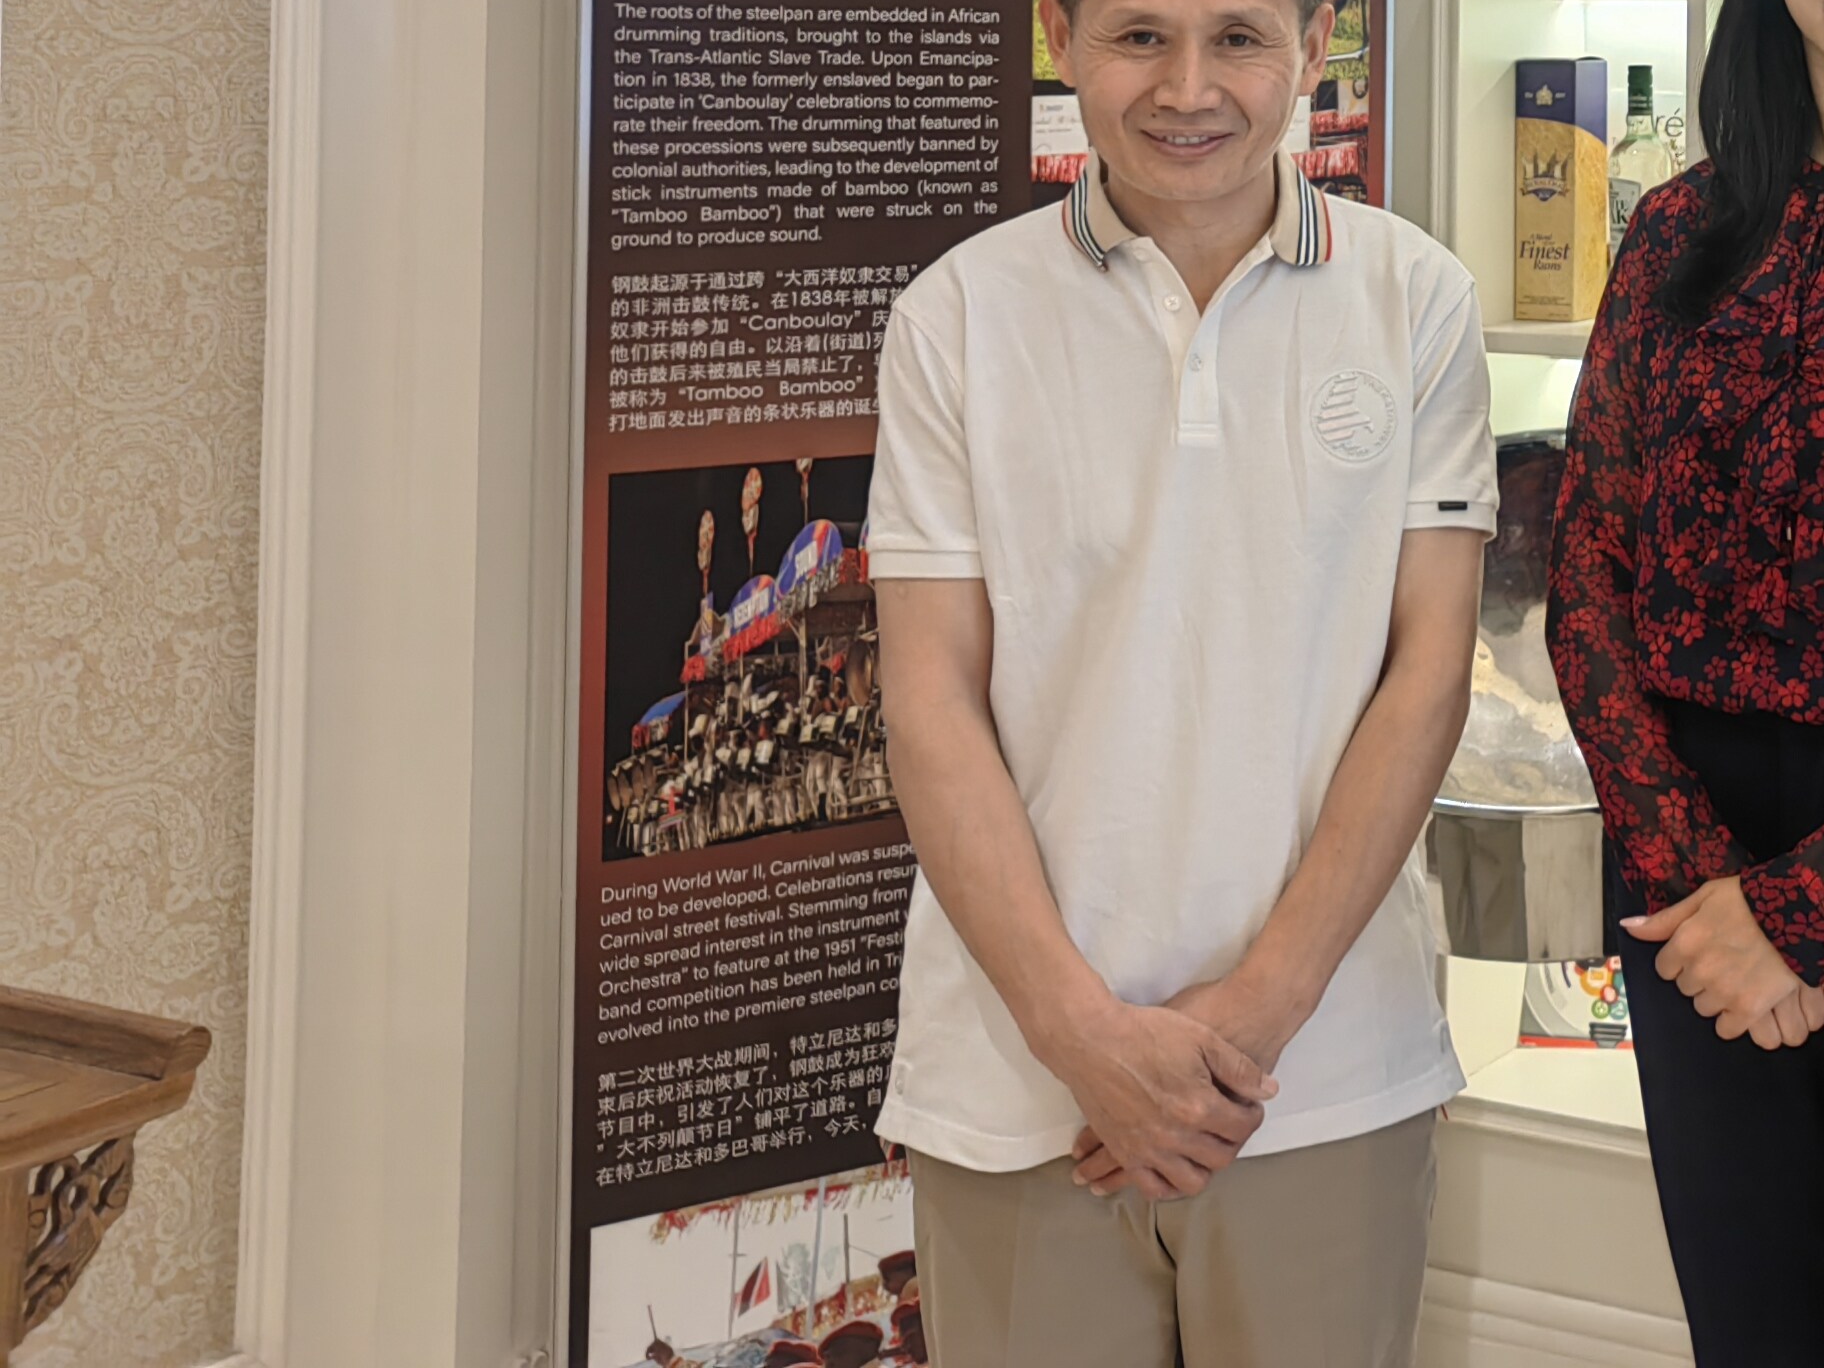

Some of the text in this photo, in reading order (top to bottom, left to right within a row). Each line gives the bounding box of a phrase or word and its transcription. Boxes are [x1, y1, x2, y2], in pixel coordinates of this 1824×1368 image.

[614, 26, 999, 46] drumming traditions, brought to the islands via
[614, 49, 999, 68] the Trans-Atlantic Slave Trade. Upon Emancipa-
[612, 136, 998, 157] these processions were subsequently banned by
[612, 157, 998, 178] colonial authorities, leading to the development of
[610, 225, 822, 249] ground to produce sound.
[1519, 241, 1571, 261] Finest
[601, 883, 657, 903] During
[662, 871, 711, 893] World
[715, 868, 748, 884] War
[752, 864, 765, 880] II,
[769, 852, 834, 876] Carnival
[838, 850, 869, 865] was
[599, 887, 908, 949] Carnival street festival. Stemming from
[598, 999, 641, 1020] band
[646, 983, 744, 1011] competition
[750, 977, 778, 992] has
[783, 969, 822, 986] been
[827, 960, 860, 978] held
[866, 958, 879, 971] in
